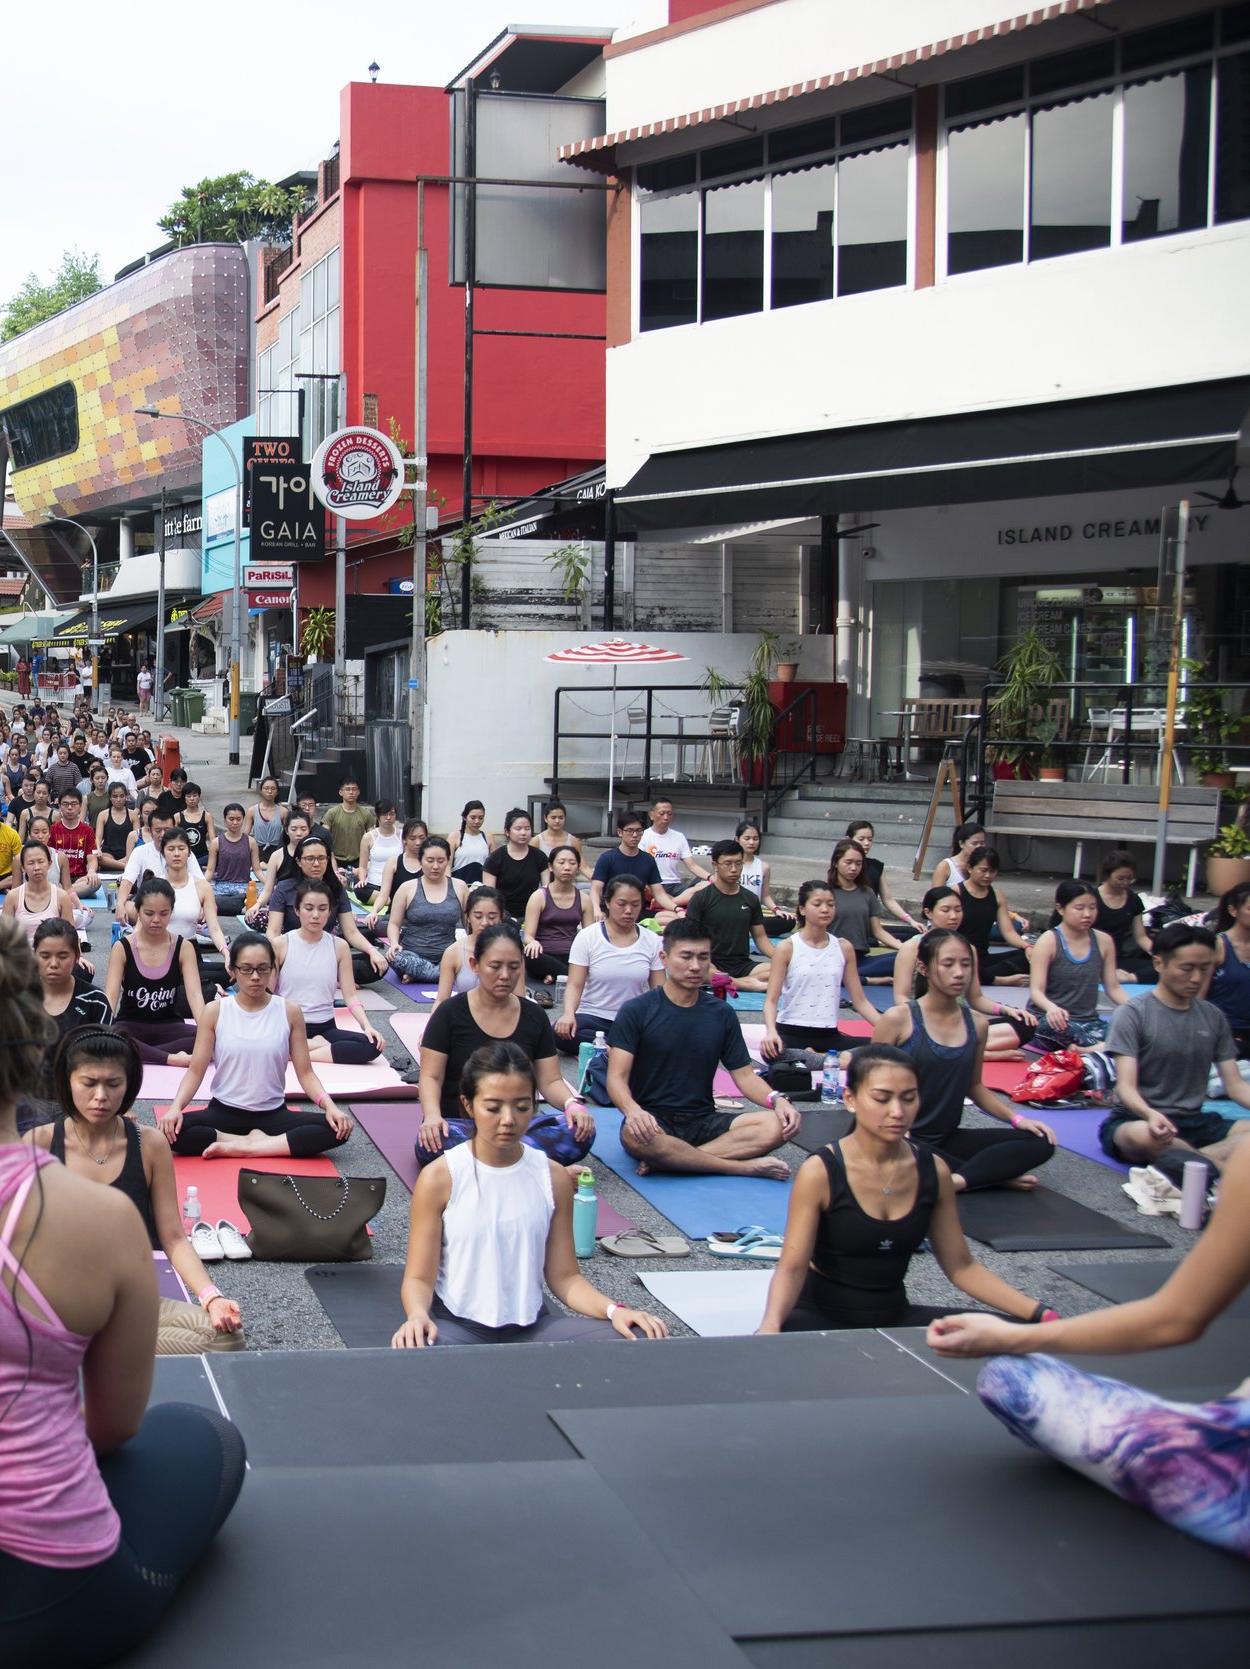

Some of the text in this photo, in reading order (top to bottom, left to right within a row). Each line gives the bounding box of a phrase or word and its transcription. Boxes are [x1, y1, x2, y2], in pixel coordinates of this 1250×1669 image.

[252, 441, 290, 456] TWO
[327, 436, 354, 467] FROZEN
[356, 436, 390, 468] DESSERTS
[340, 480, 379, 492] Island
[326, 487, 392, 508] Creamery
[164, 516, 181, 537] ittle
[260, 521, 317, 540] GAIA
[997, 514, 1210, 546] ISLAND CREAMY
[248, 571, 292, 581] PaRiSiL
